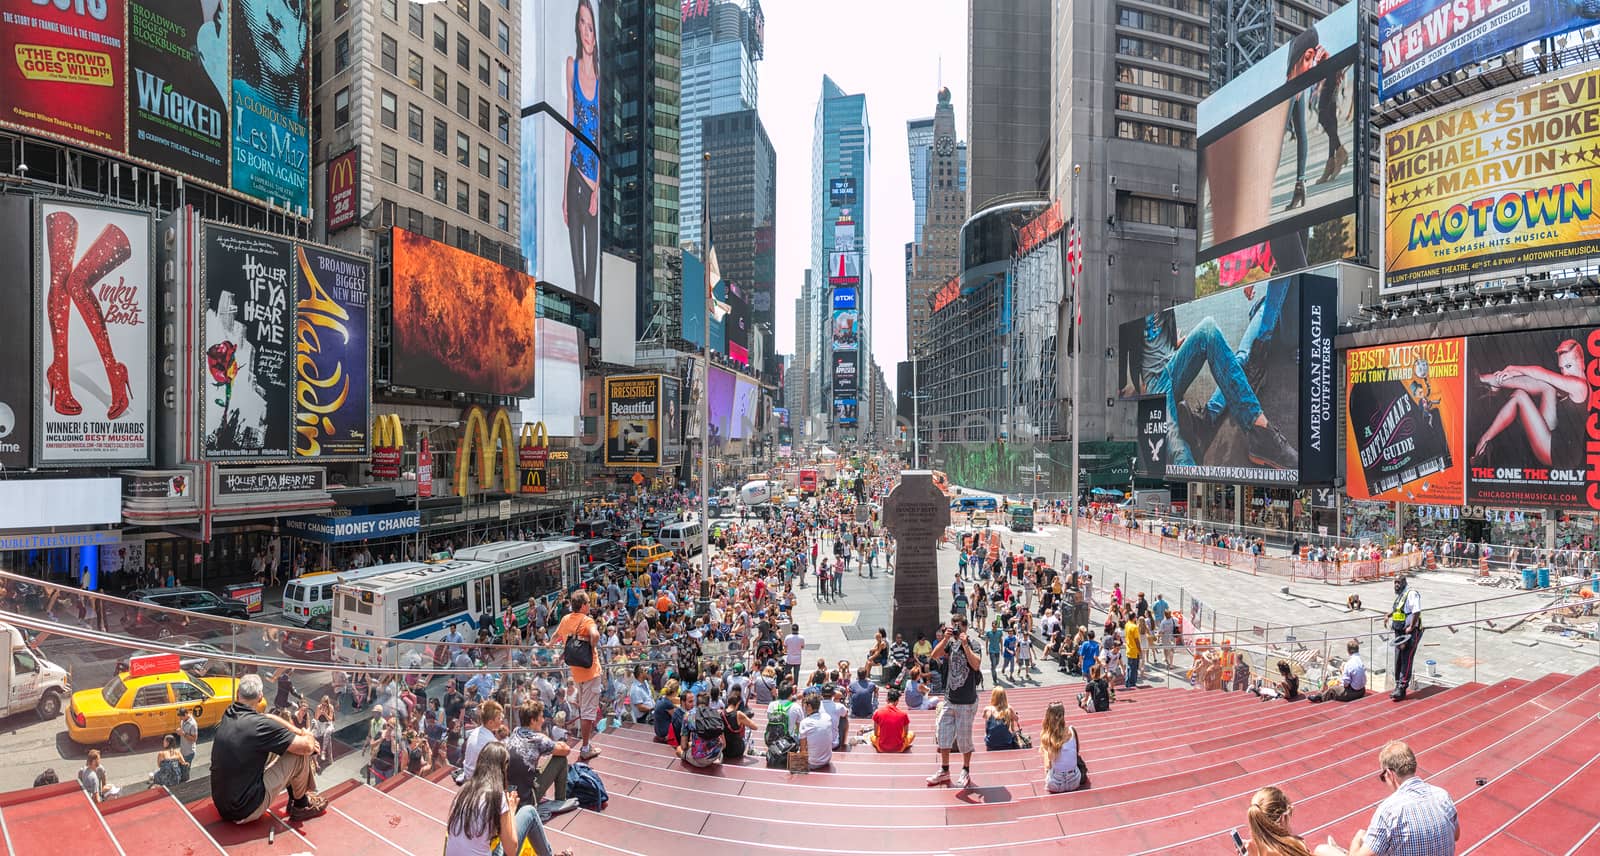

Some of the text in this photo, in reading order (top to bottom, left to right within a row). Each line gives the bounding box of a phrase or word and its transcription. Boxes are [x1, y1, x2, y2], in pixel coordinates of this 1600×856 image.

[3, 11, 14, 23] THE
[133, 14, 168, 38] BIGGEST
[1384, 5, 1528, 88] BROADWAY'S TONY-WINNING MUSICAL
[18, 47, 106, 67] "THE CROWD
[24, 60, 110, 78] GOES WILD!"
[244, 96, 306, 138] GLORIOUS NEW
[1388, 76, 1600, 158] DIANA STEVI
[248, 152, 276, 176] BORN
[1388, 137, 1488, 184] MICHAEL
[1437, 149, 1556, 196] MARVIN
[333, 188, 352, 202] OPEN
[330, 209, 354, 226] HOURS
[334, 199, 350, 216] 24
[1408, 179, 1592, 251] MOTOWN
[1434, 230, 1559, 257] THE SMASH HITS MUSICAL
[242, 253, 288, 287] HOLLER
[1392, 268, 1440, 284] LUNT-FONTANNE
[336, 274, 365, 292] BIGGEST
[250, 277, 286, 310] IF YA
[332, 286, 350, 301] NEW
[104, 303, 144, 326] Boots
[244, 300, 282, 324] HEAR
[257, 320, 284, 344] ME
[1350, 341, 1460, 372] BEST MUSICAL!
[1310, 304, 1322, 452] AMERICAN EAGLE
[1322, 337, 1331, 421] OUTFITTERS
[1350, 364, 1458, 384] 2014 TONY AWARD WINNER
[612, 401, 655, 414] Beautiful
[1150, 410, 1162, 420] AEO
[46, 422, 144, 434] WINNER! 6 TONY AWARDS
[1144, 422, 1168, 434] JEANS
[1360, 393, 1412, 468] GENTLEMAN'S
[1364, 426, 1372, 438] A
[1383, 436, 1414, 460] GUIDE
[226, 474, 316, 488] HOLLER IF YA HEAR ME
[1166, 464, 1298, 482] AMERICAN EAGLE OUTFITTERS
[1472, 467, 1586, 481] THE ONE THE ONLY
[1251, 498, 1264, 506] AEO
[1478, 490, 1578, 501] CHICAGOTHEMUSICAL.COM
[1418, 506, 1525, 523] GRAND SLAM
[286, 520, 334, 534] MONEY CHANGE
[335, 516, 420, 536] MONEY CHANGE
